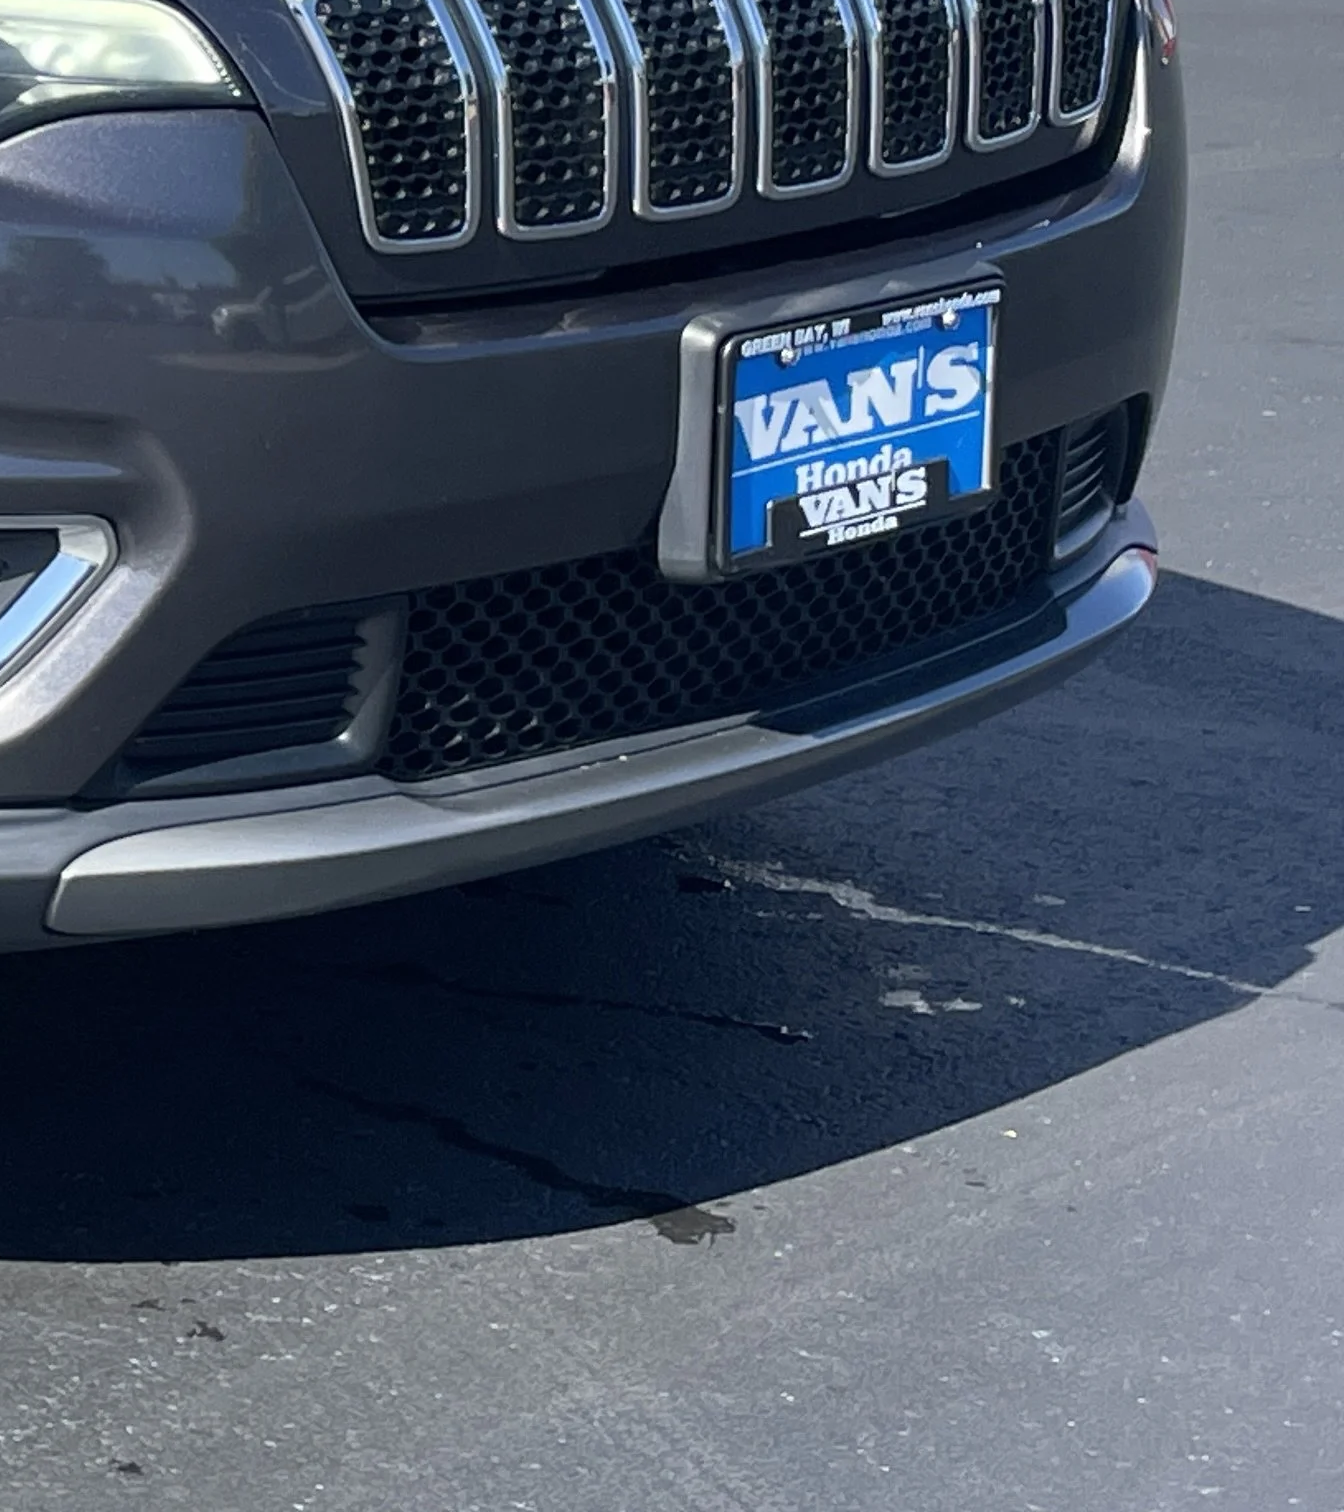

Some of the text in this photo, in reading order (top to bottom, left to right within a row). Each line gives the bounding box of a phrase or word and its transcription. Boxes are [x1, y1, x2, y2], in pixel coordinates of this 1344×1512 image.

[741, 331, 792, 358] GREEN
[734, 341, 980, 462] VAN'S
[796, 444, 913, 494] Honda
[799, 466, 928, 528] VAN'S
[827, 515, 899, 546] Honda
